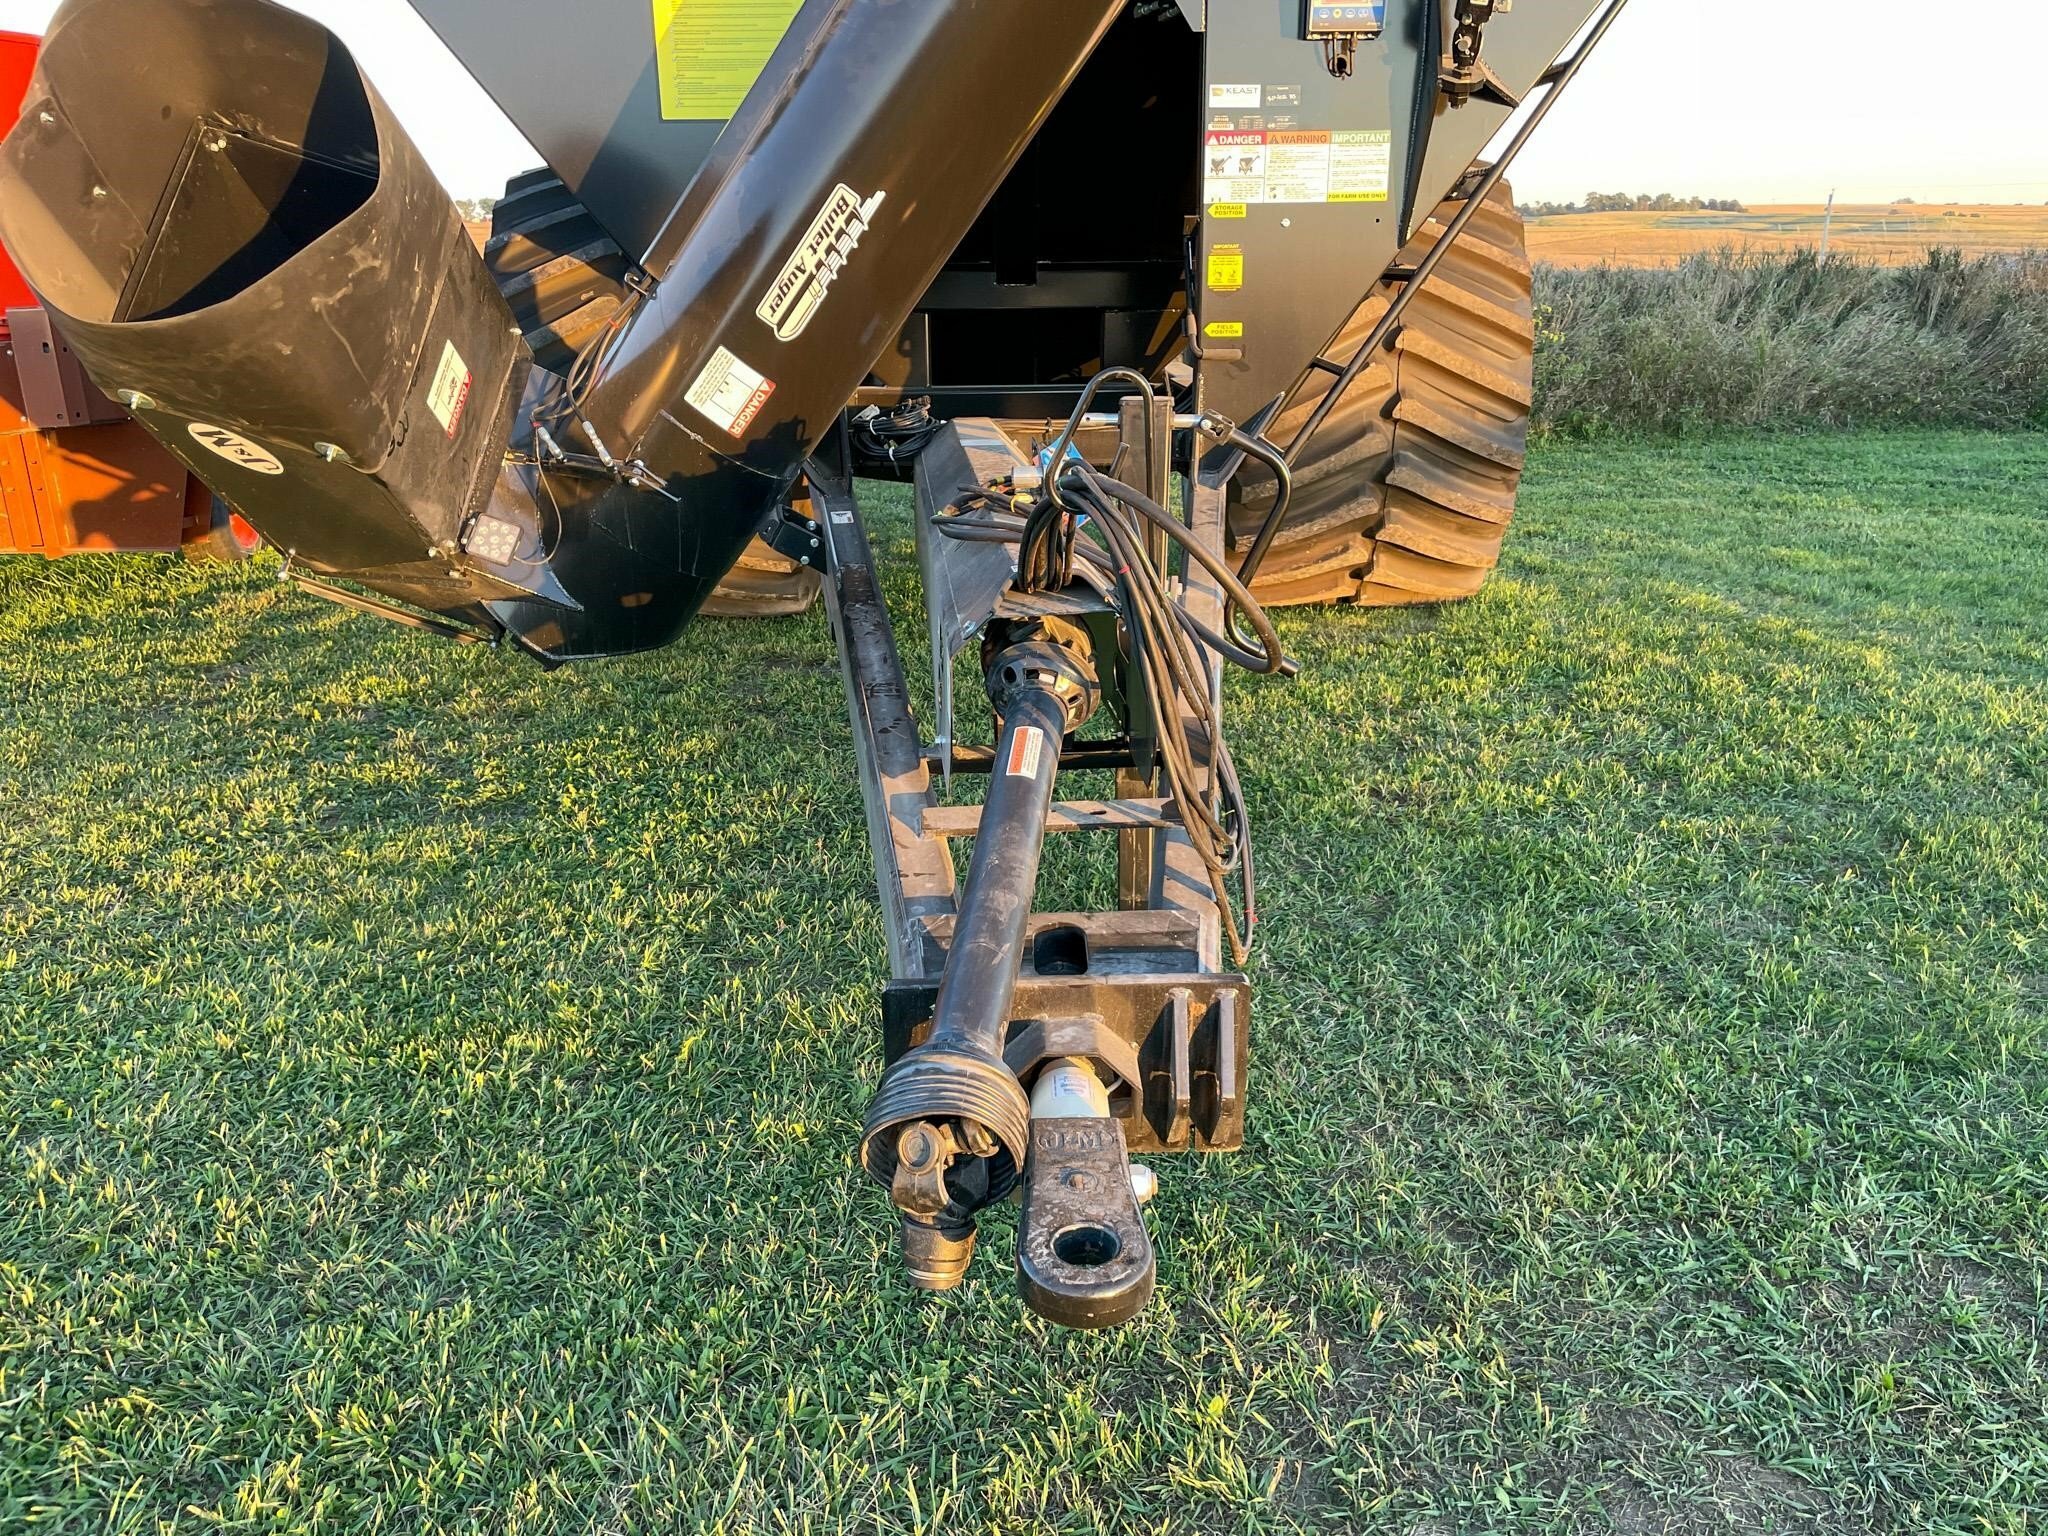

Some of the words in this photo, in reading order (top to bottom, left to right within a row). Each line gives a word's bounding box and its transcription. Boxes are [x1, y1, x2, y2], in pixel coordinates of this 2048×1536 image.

[1219, 135, 1262, 144] DANGER
[1281, 135, 1327, 144] WARNING
[1332, 133, 1390, 143] IMPORTANT
[807, 193, 850, 258] Bullet
[766, 254, 808, 318] Auger
[449, 385, 468, 438] DANGER
[730, 390, 767, 435] DANGER
